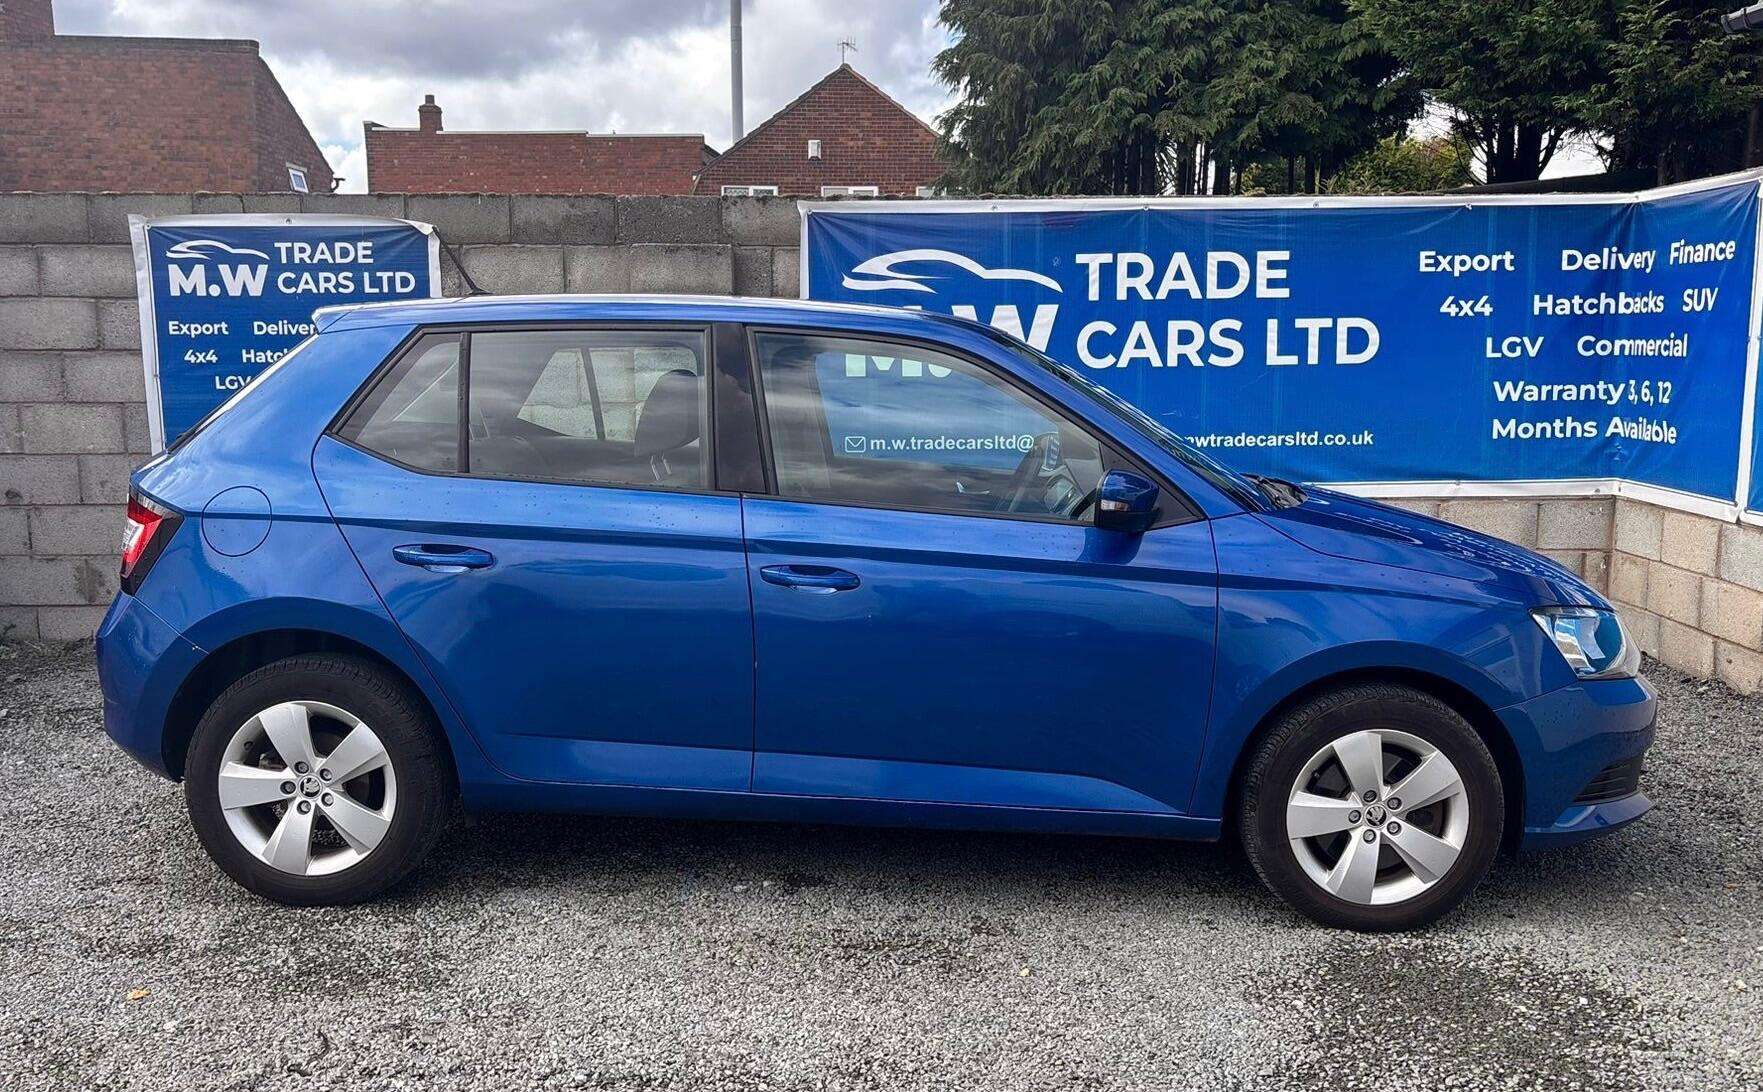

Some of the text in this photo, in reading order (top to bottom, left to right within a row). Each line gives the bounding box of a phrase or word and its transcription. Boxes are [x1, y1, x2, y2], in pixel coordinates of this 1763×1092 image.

[274, 242, 374, 264] TRADE
[1419, 239, 1736, 276] Export Delivery Finance
[167, 264, 269, 297] M.W
[277, 271, 416, 294] CARS LTD
[1075, 250, 1290, 301] TRADE
[1439, 288, 1719, 317] 4x4 Hatchbacks SUV
[168, 320, 317, 338] Export Deliver
[184, 349, 218, 364] 4x4
[1076, 317, 1380, 369] CARS LTD
[1486, 332, 1688, 358] LGV Commercial
[215, 375, 252, 390] LGV
[1493, 379, 1672, 407] Warranty 3, 6, 12
[870, 433, 1034, 453] m.w.tradecarsltd@
[1492, 416, 1677, 445] Months Available
